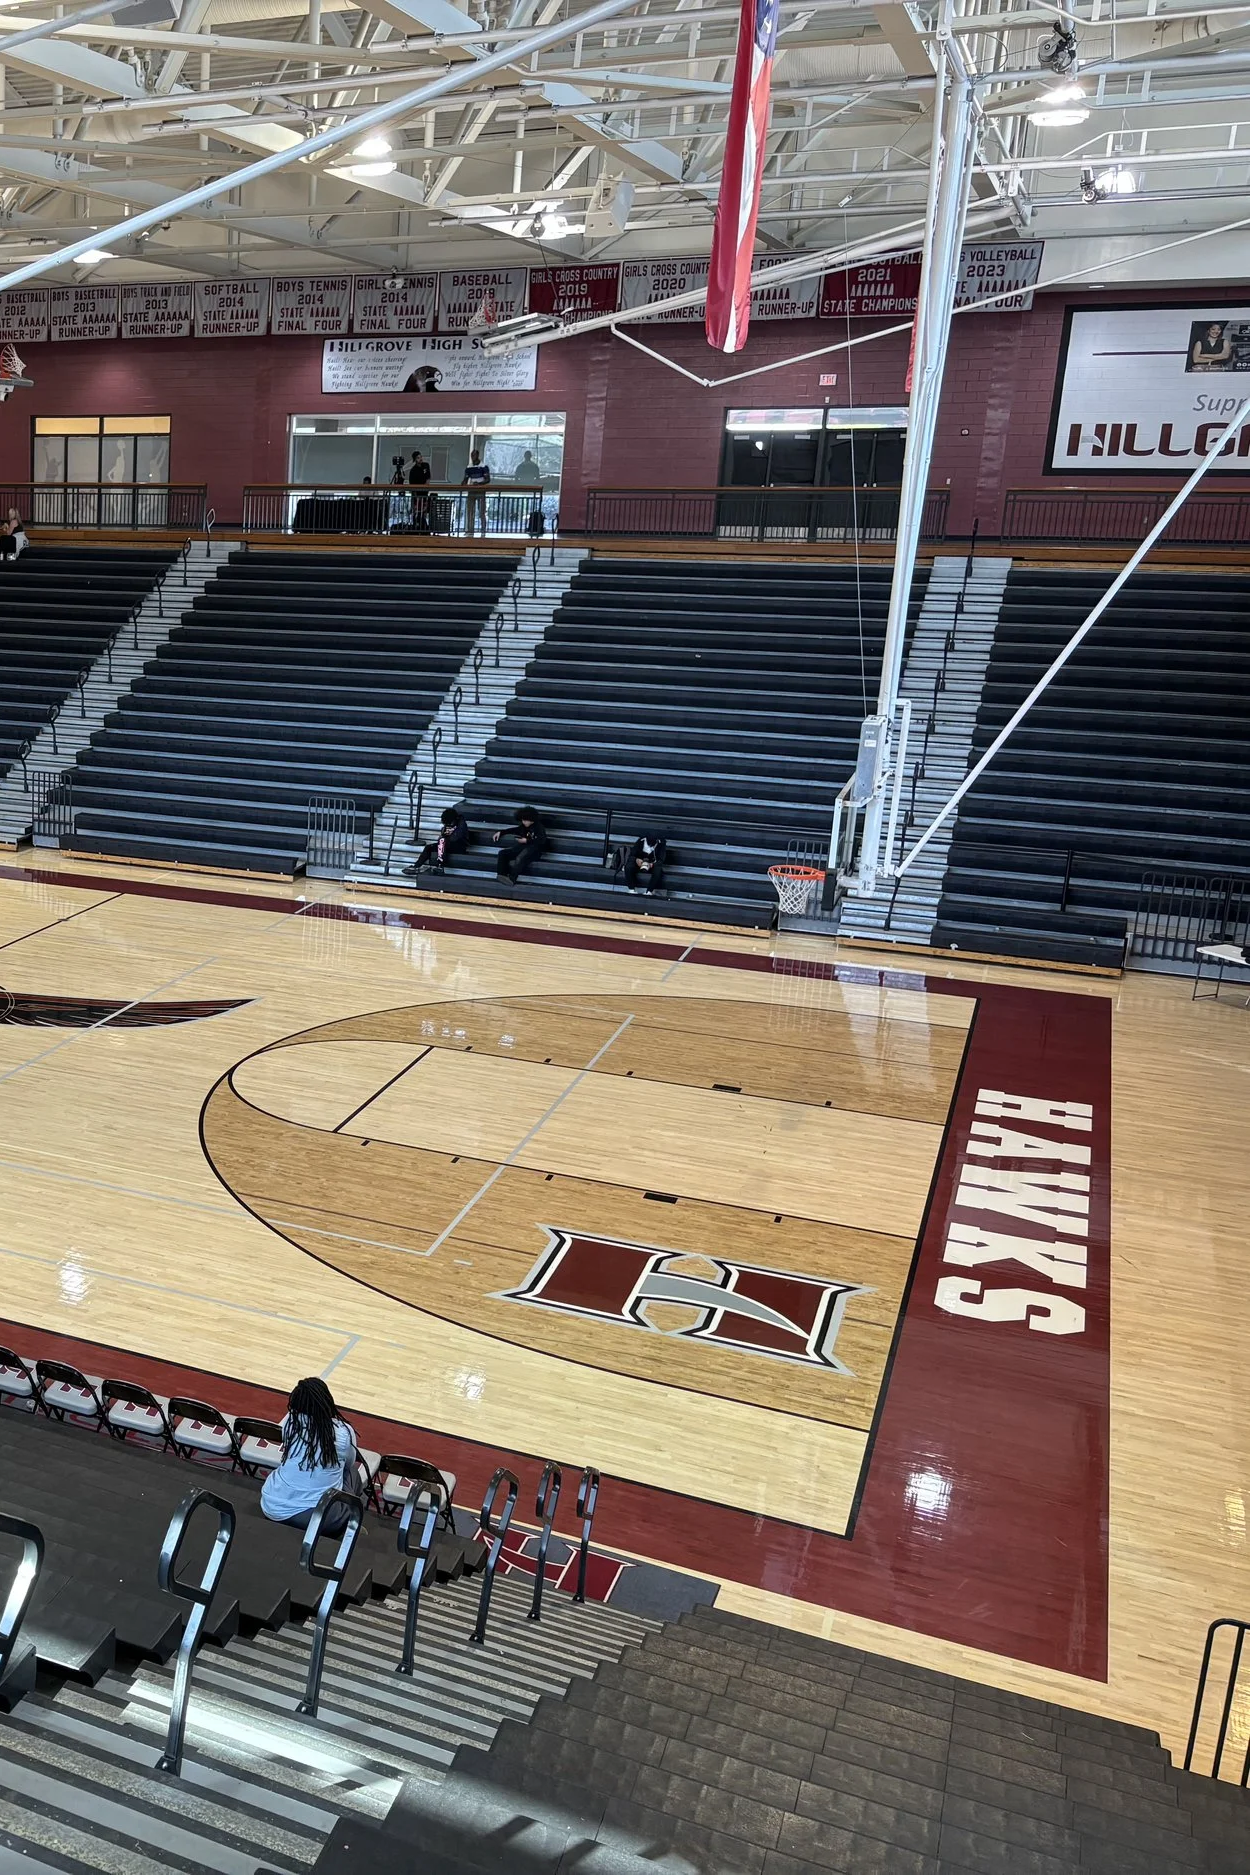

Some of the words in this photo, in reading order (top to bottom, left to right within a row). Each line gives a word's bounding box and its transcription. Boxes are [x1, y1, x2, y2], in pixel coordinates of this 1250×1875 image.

[970, 249, 1037, 262] VOLLEYBALL
[531, 271, 553, 283] GIRLS
[555, 270, 579, 282] CROSS
[583, 267, 618, 280] COUNTRY
[625, 265, 647, 277] GIRLS
[651, 264, 676, 275] CROSS
[858, 268, 891, 281] 2021
[967, 265, 1005, 277] 2023
[400, 277, 434, 289] ENNIS
[452, 273, 512, 286] BASEBALL
[653, 278, 686, 290] 2020
[205, 283, 259, 295] SOFTBALL
[277, 281, 304, 292] BOYS
[310, 280, 347, 291] TENNIS
[558, 283, 588, 296] 2019
[7, 292, 46, 303] BASKETBALL
[53, 291, 69, 301] BOYS
[75, 288, 116, 299] BASKETBALL
[123, 288, 137, 298] BOYS
[381, 292, 408, 303] 2014
[145, 300, 168, 310] 2013
[219, 297, 244, 307] 2014
[298, 294, 324, 305] 2014
[824, 299, 855, 313] STATE
[862, 297, 918, 311] CHAMPIONS
[5, 306, 26, 316] 2012
[74, 302, 96, 313] 2013
[280, 308, 304, 318] STATE
[363, 306, 387, 317] STATE
[758, 302, 814, 316] RUNNER-UP
[53, 315, 77, 326] STATE
[123, 312, 149, 322] STATE
[203, 310, 225, 321] STATE
[130, 324, 182, 335] RUNNER-UP
[202, 322, 259, 334] RUNNER-UP
[278, 320, 306, 331] FINAL
[315, 320, 341, 330] FOUR
[360, 319, 390, 330] FINAL
[398, 318, 426, 329] FOUR
[59, 326, 110, 338] RUNNER-UP
[330, 341, 412, 353] HILLGROVE
[422, 339, 462, 350] HIGH
[934, 1088, 1093, 1335] HAWKS
